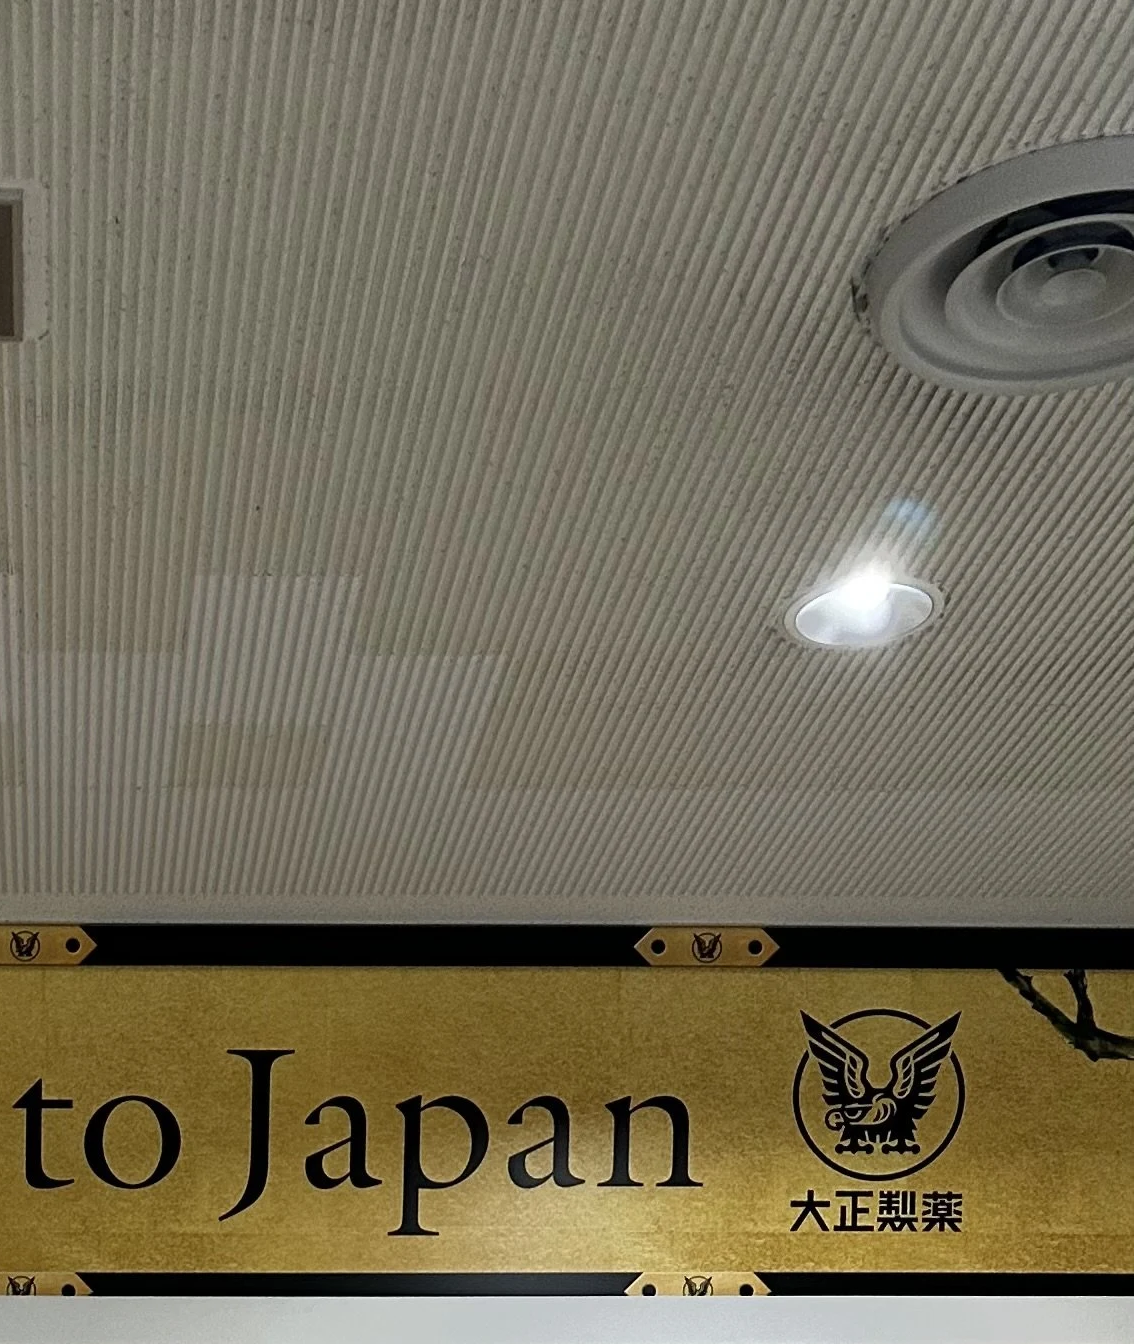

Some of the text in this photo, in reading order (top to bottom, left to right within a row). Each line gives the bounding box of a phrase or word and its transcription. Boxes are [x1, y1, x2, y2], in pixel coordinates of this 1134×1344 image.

[12, 1077, 182, 1191] to
[218, 1047, 704, 1237] Japan
[788, 1189, 965, 1234] 大正製薬
